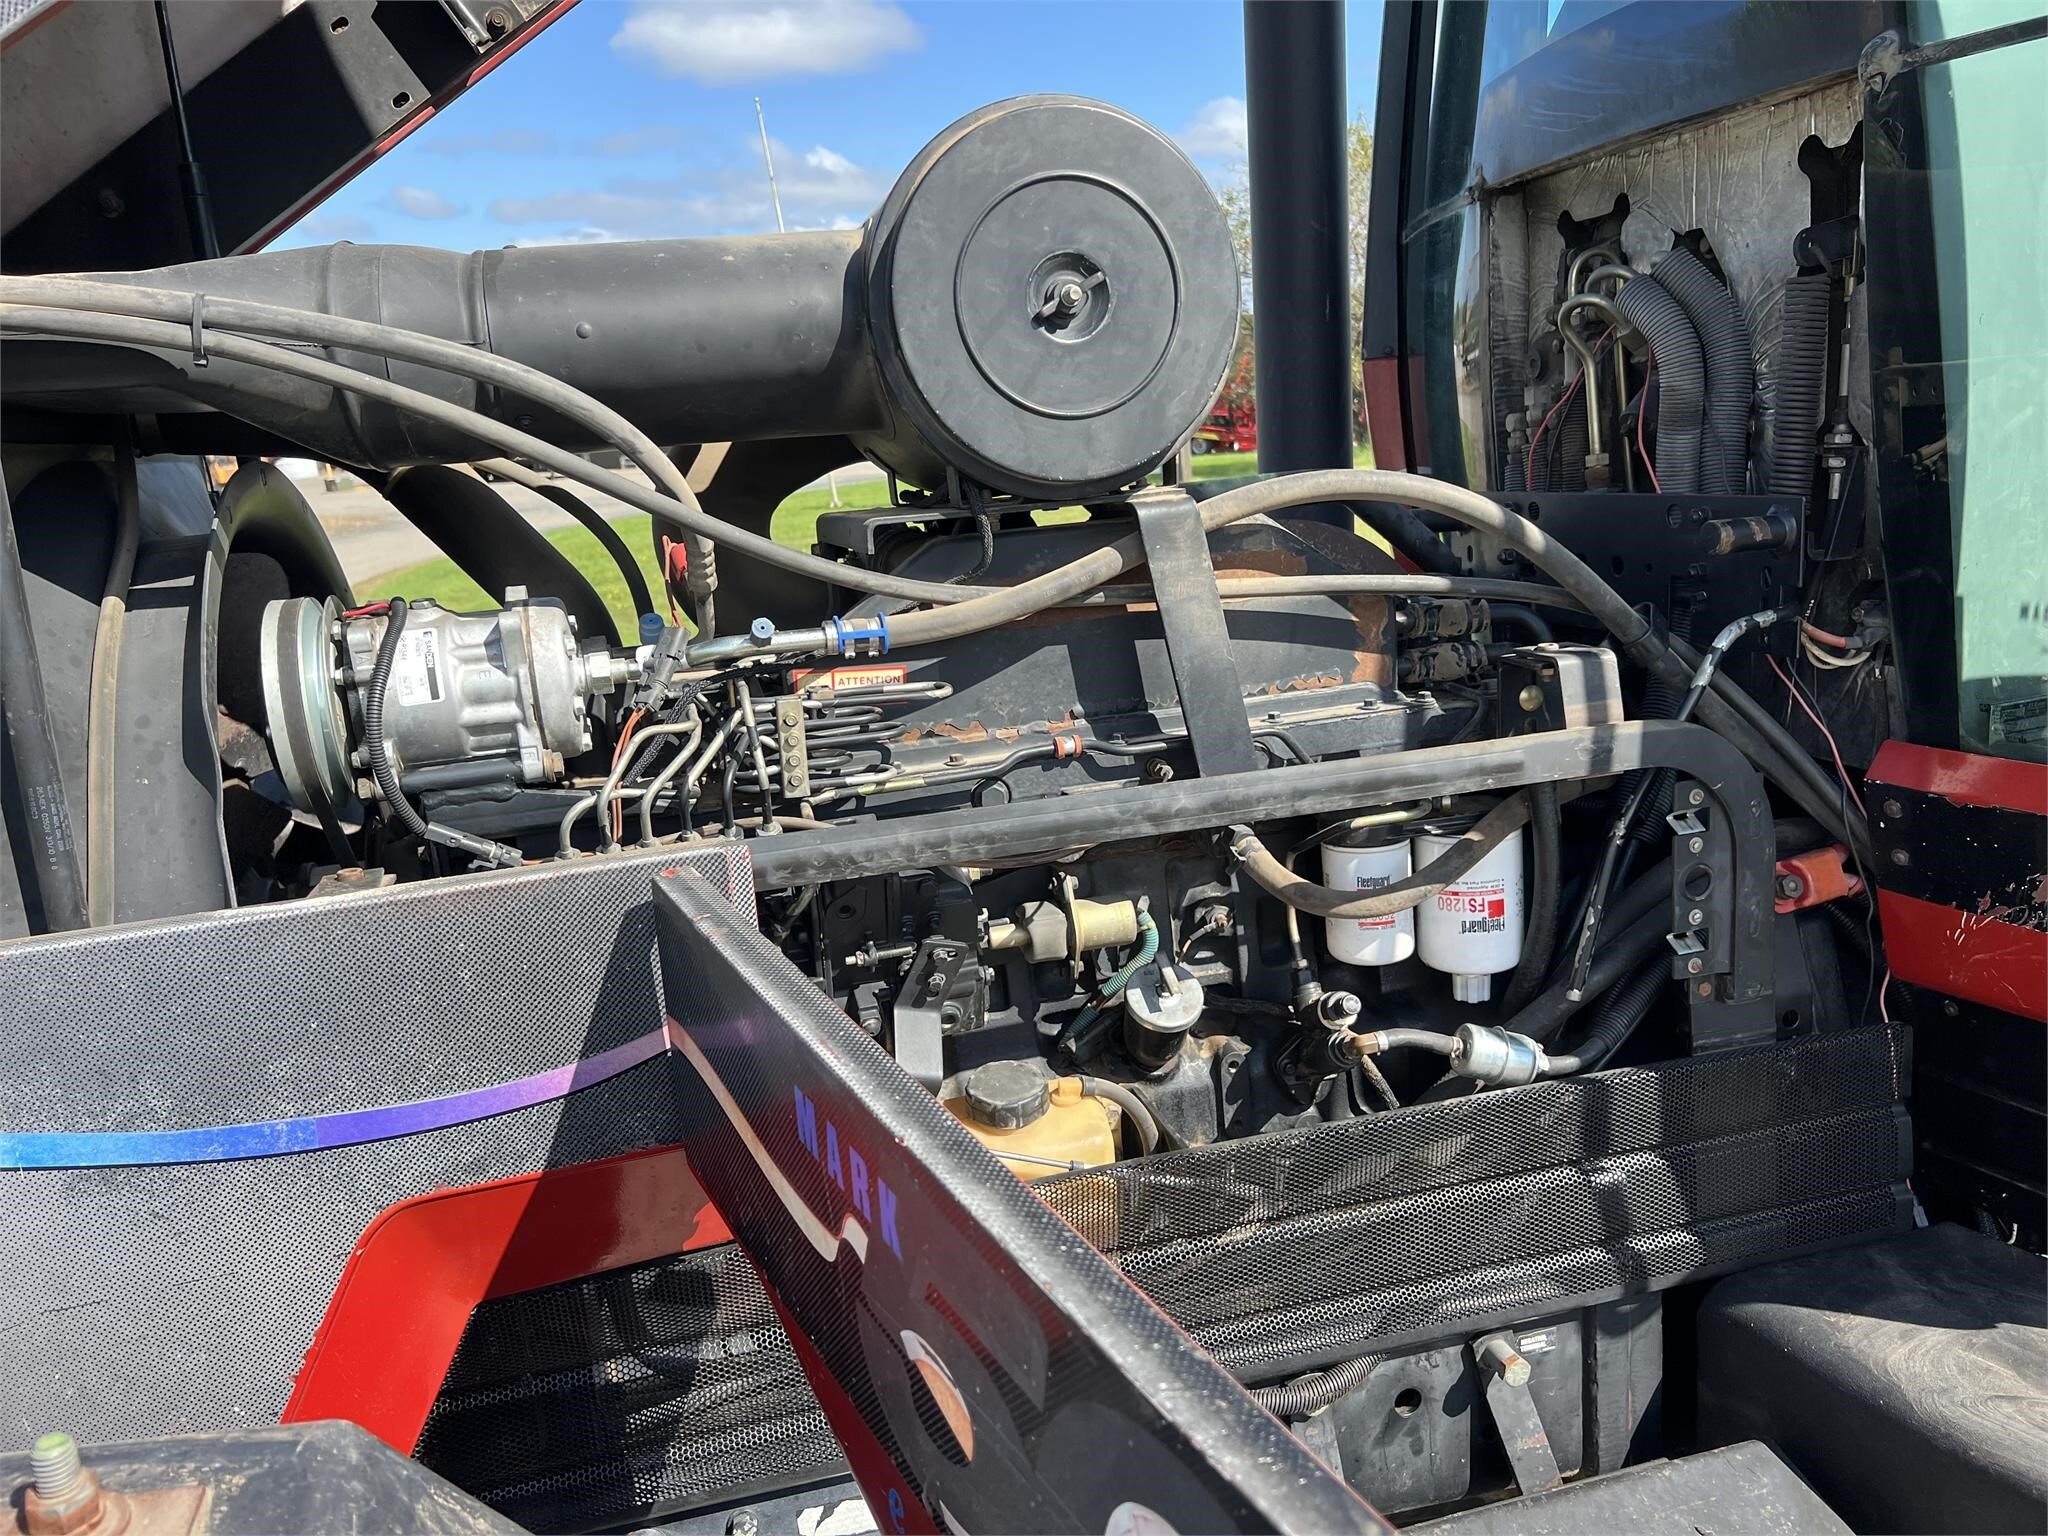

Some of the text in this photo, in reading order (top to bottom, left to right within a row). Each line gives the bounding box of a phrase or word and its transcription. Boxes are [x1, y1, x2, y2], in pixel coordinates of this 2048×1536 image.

[838, 675, 901, 687] ATTENTION
[1357, 875, 1390, 893] Fleetguard
[1437, 896, 1485, 913] FS1280
[1461, 917, 1505, 934] Fleetguard
[794, 1084, 904, 1263] MARK
